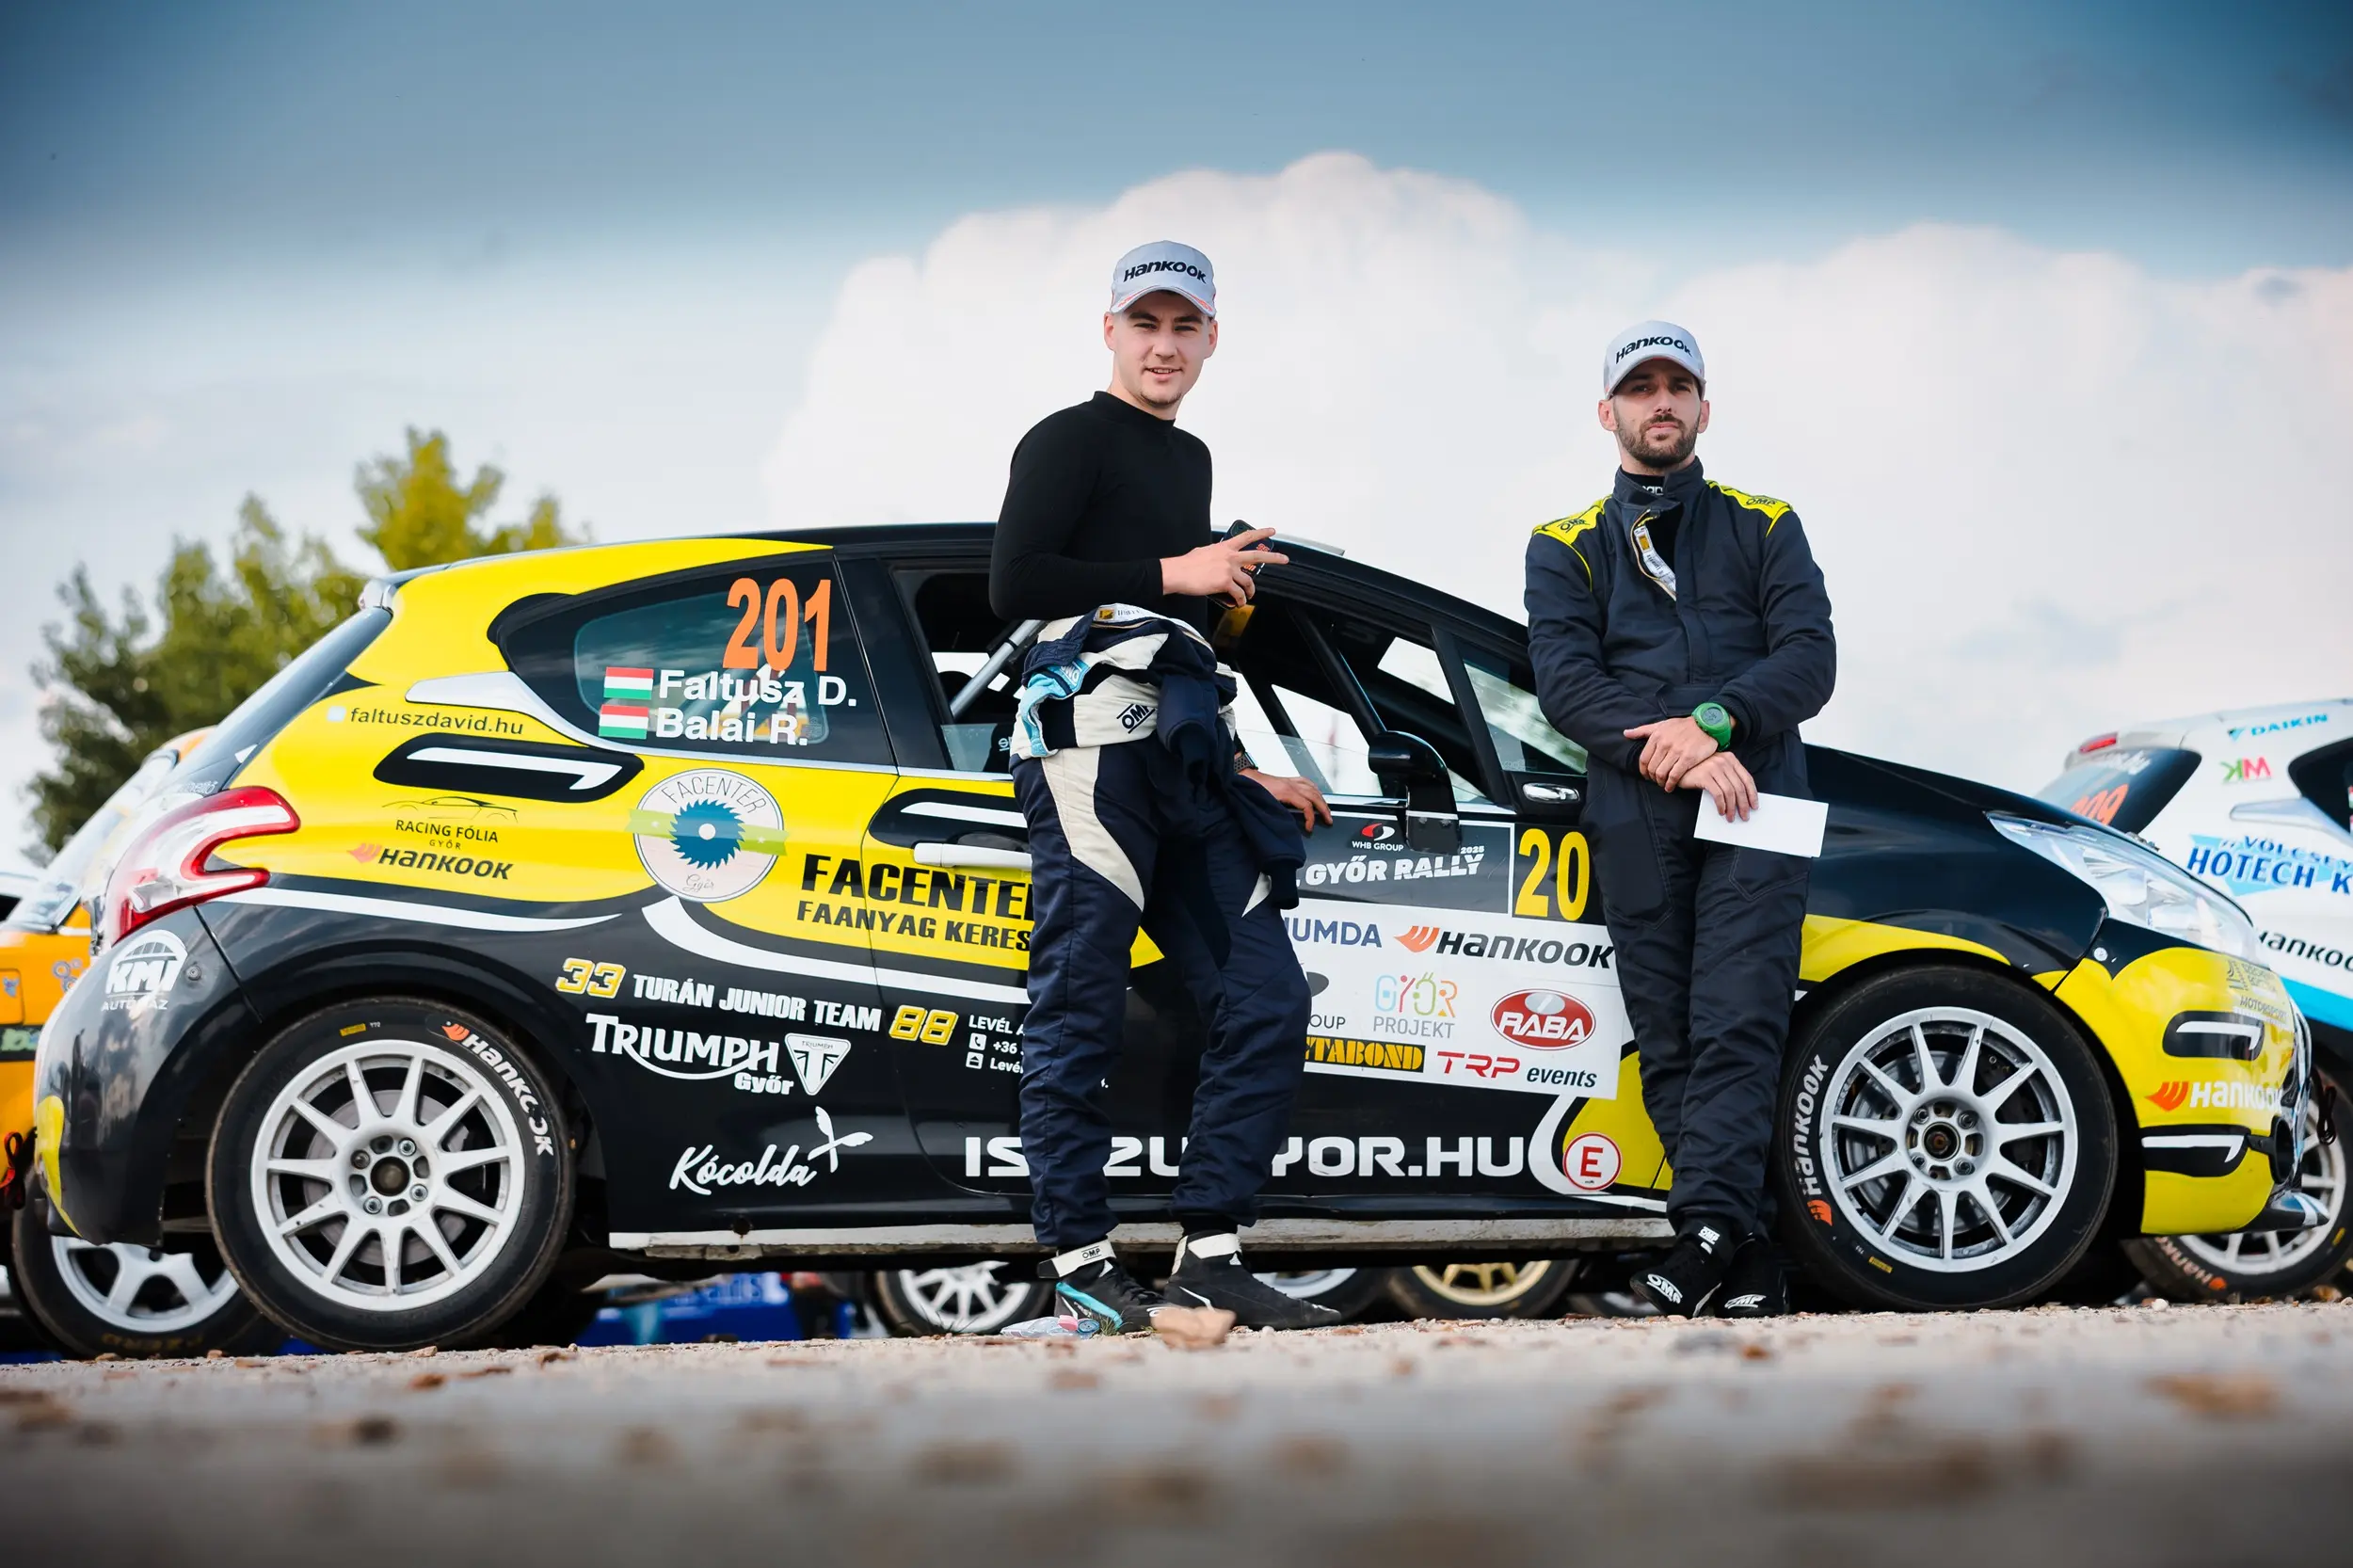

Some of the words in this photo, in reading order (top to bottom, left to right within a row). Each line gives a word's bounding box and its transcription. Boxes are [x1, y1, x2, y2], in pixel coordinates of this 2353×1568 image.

[722, 577, 832, 673] 201
[660, 669, 805, 704] Faltusz
[818, 675, 857, 707] D.
[350, 708, 524, 736] faltuszdavid.hu
[656, 707, 756, 744] Balai
[769, 713, 808, 746] R.
[2251, 712, 2328, 737] DAIKIN
[661, 776, 767, 814] FACENTER
[395, 820, 452, 838] RACING
[456, 824, 499, 844] FÓLIA
[1352, 840, 1372, 851] WHB
[1373, 841, 1404, 852] GROUP
[1461, 844, 1485, 855] 2025
[1394, 853, 1485, 882] RALLY
[801, 853, 1035, 921] FACENTE
[796, 900, 936, 939] FAANYAG
[555, 957, 627, 1000] 33
[632, 973, 715, 1008] TURÁN
[719, 987, 808, 1021] JUNIOR
[813, 999, 883, 1032] TEAM
[888, 1004, 959, 1047] 88
[968, 1014, 1014, 1034] LEVÉL
[1373, 1016, 1455, 1039] PROJEKT
[585, 1013, 779, 1080] TRIUMPH
[993, 1040, 1017, 1054] +36
[733, 1070, 794, 1095] Győr
[1436, 1051, 1522, 1080] TRP
[1527, 1066, 1597, 1088] events
[669, 1144, 818, 1196] Kócolda
[1580, 1145, 1604, 1177] E
[1082, 1248, 1101, 1259] OMP
